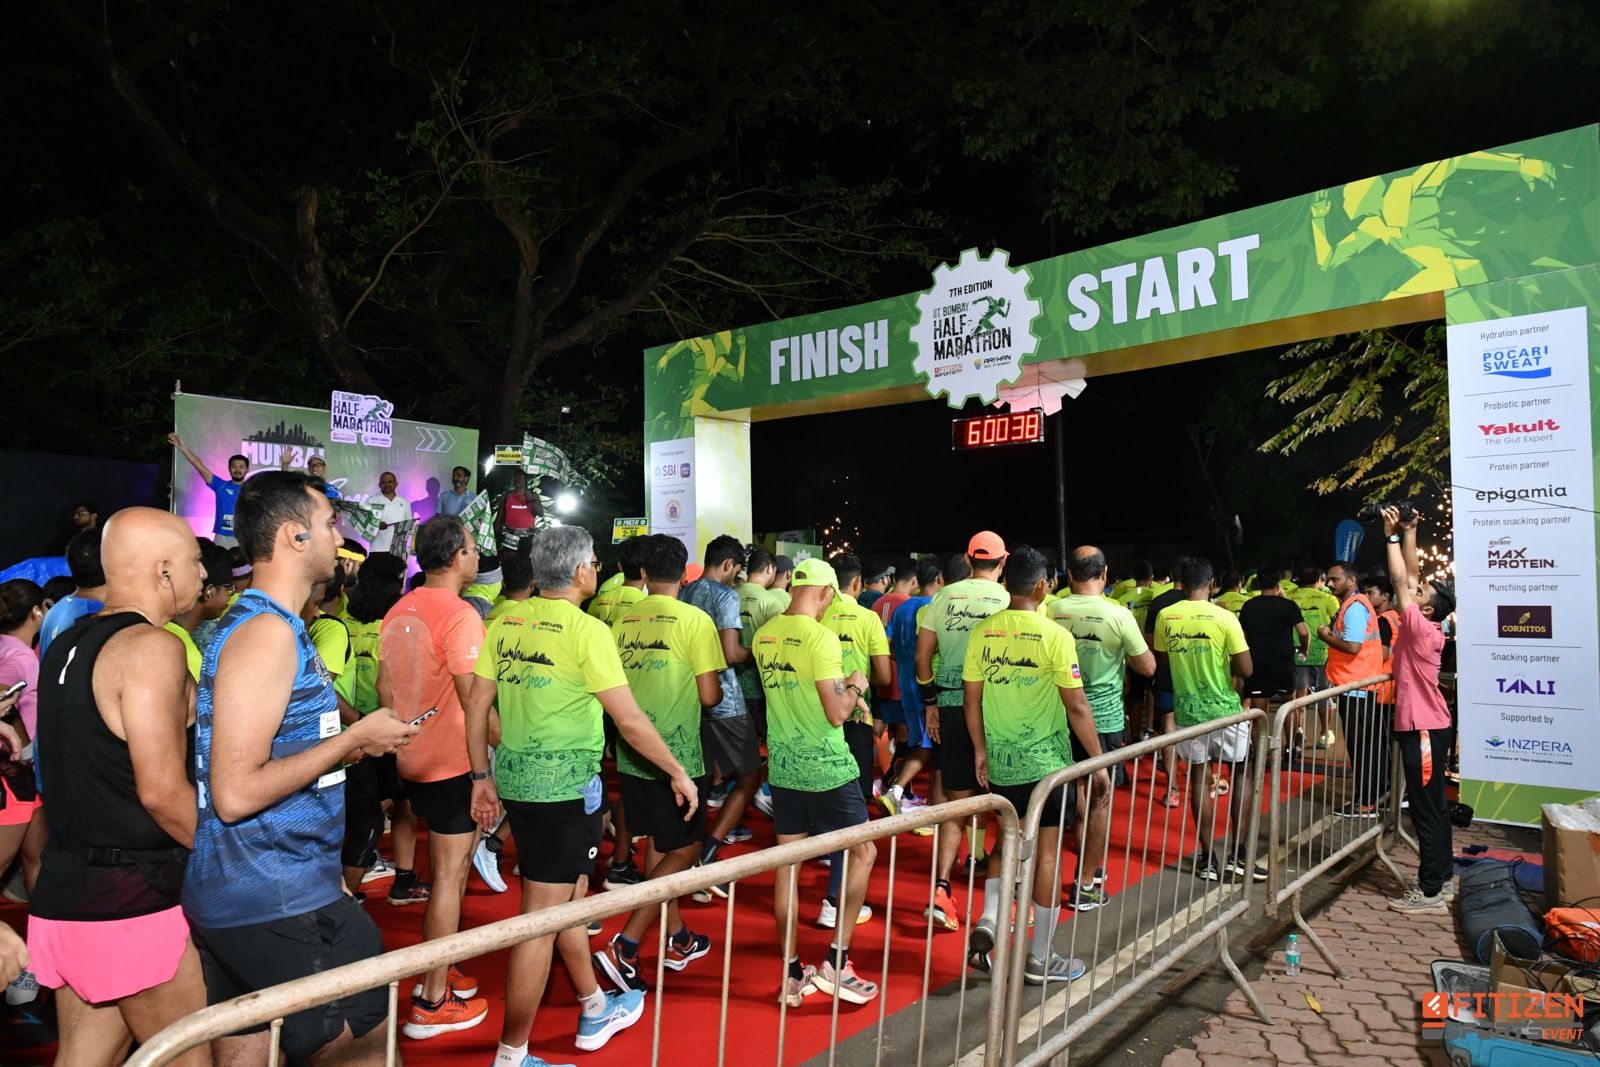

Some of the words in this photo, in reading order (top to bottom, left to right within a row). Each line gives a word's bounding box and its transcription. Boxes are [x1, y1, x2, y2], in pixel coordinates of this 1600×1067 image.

[949, 287, 962, 298] 7TH
[964, 280, 992, 294] EDITION
[1067, 233, 1260, 332] START
[943, 302, 969, 316] BOMBAY
[934, 314, 967, 340] HALF
[1480, 329, 1517, 340] Hydration
[1520, 325, 1549, 336] partner
[934, 326, 1012, 361] MARATHON
[770, 320, 888, 385] FINISH
[1483, 346, 1548, 362] POCARI
[1483, 356, 1542, 372] SWEAT
[334, 400, 360, 416] HALF
[1484, 400, 1518, 410] Probiotic
[1522, 398, 1550, 408] partner
[333, 415, 390, 434] MARATHON
[1478, 419, 1560, 435] Yakult
[1524, 434, 1553, 443] Expert
[662, 464, 677, 477] SBI
[1490, 462, 1517, 471] Protein
[1520, 461, 1549, 470] partner
[1476, 484, 1567, 503] epigamia
[1473, 518, 1500, 526] Protein
[1503, 517, 1538, 526] snacking
[1541, 516, 1571, 525] partner
[1488, 548, 1527, 559] MAX
[1488, 559, 1554, 568] PROTEIN
[1489, 584, 1526, 593] Munching
[1529, 584, 1558, 592] partner
[1492, 653, 1528, 663] Snacking
[1530, 654, 1560, 663] partner
[1496, 678, 1555, 695] TAALI
[1501, 712, 1541, 723] Supported
[1544, 715, 1554, 725] by
[1508, 739, 1572, 753] INZPERA
